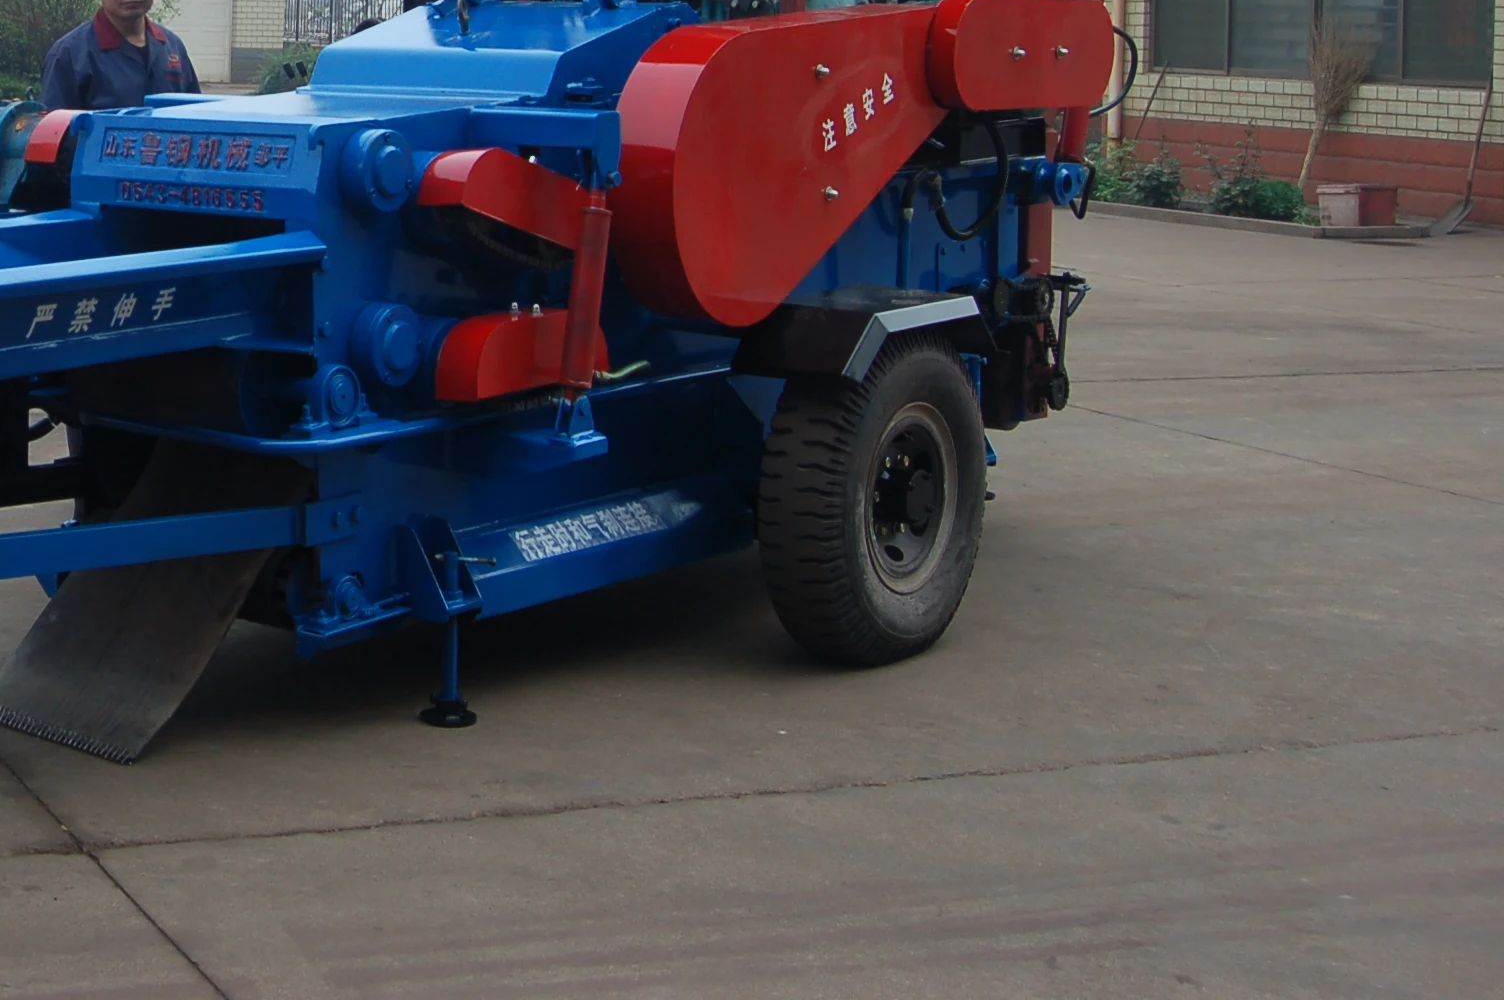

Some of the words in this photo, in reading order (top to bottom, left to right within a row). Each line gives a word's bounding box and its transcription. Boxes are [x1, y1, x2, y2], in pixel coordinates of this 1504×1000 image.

[822, 72, 894, 152] 注意安全
[120, 180, 264, 213] 0543-4816555
[26, 287, 177, 339] 严禁伸手
